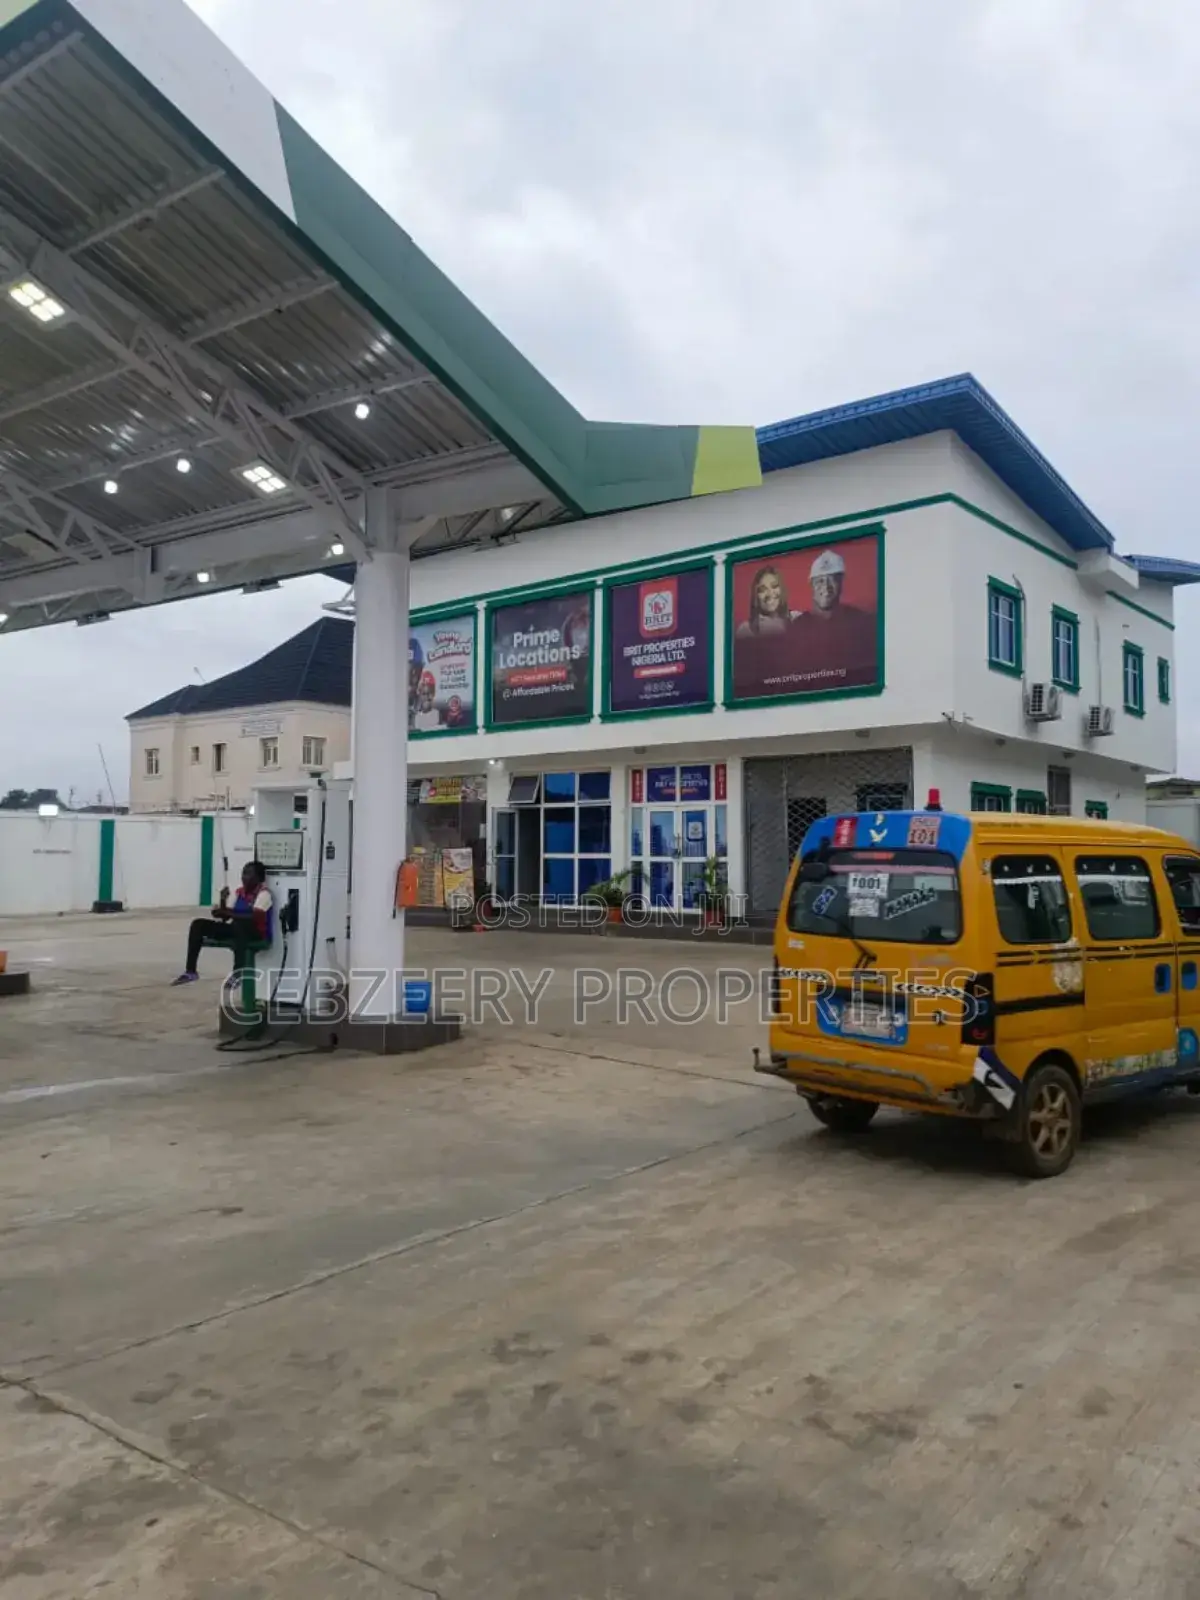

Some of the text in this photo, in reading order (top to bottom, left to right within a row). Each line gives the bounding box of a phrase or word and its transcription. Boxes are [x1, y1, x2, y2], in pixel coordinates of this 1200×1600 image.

[645, 613, 672, 625] BRIT
[513, 624, 560, 648] Prime
[623, 636, 695, 657] BRIT PROPERTIES
[499, 644, 581, 669] Locations
[631, 653, 666, 666] NIGERIA
